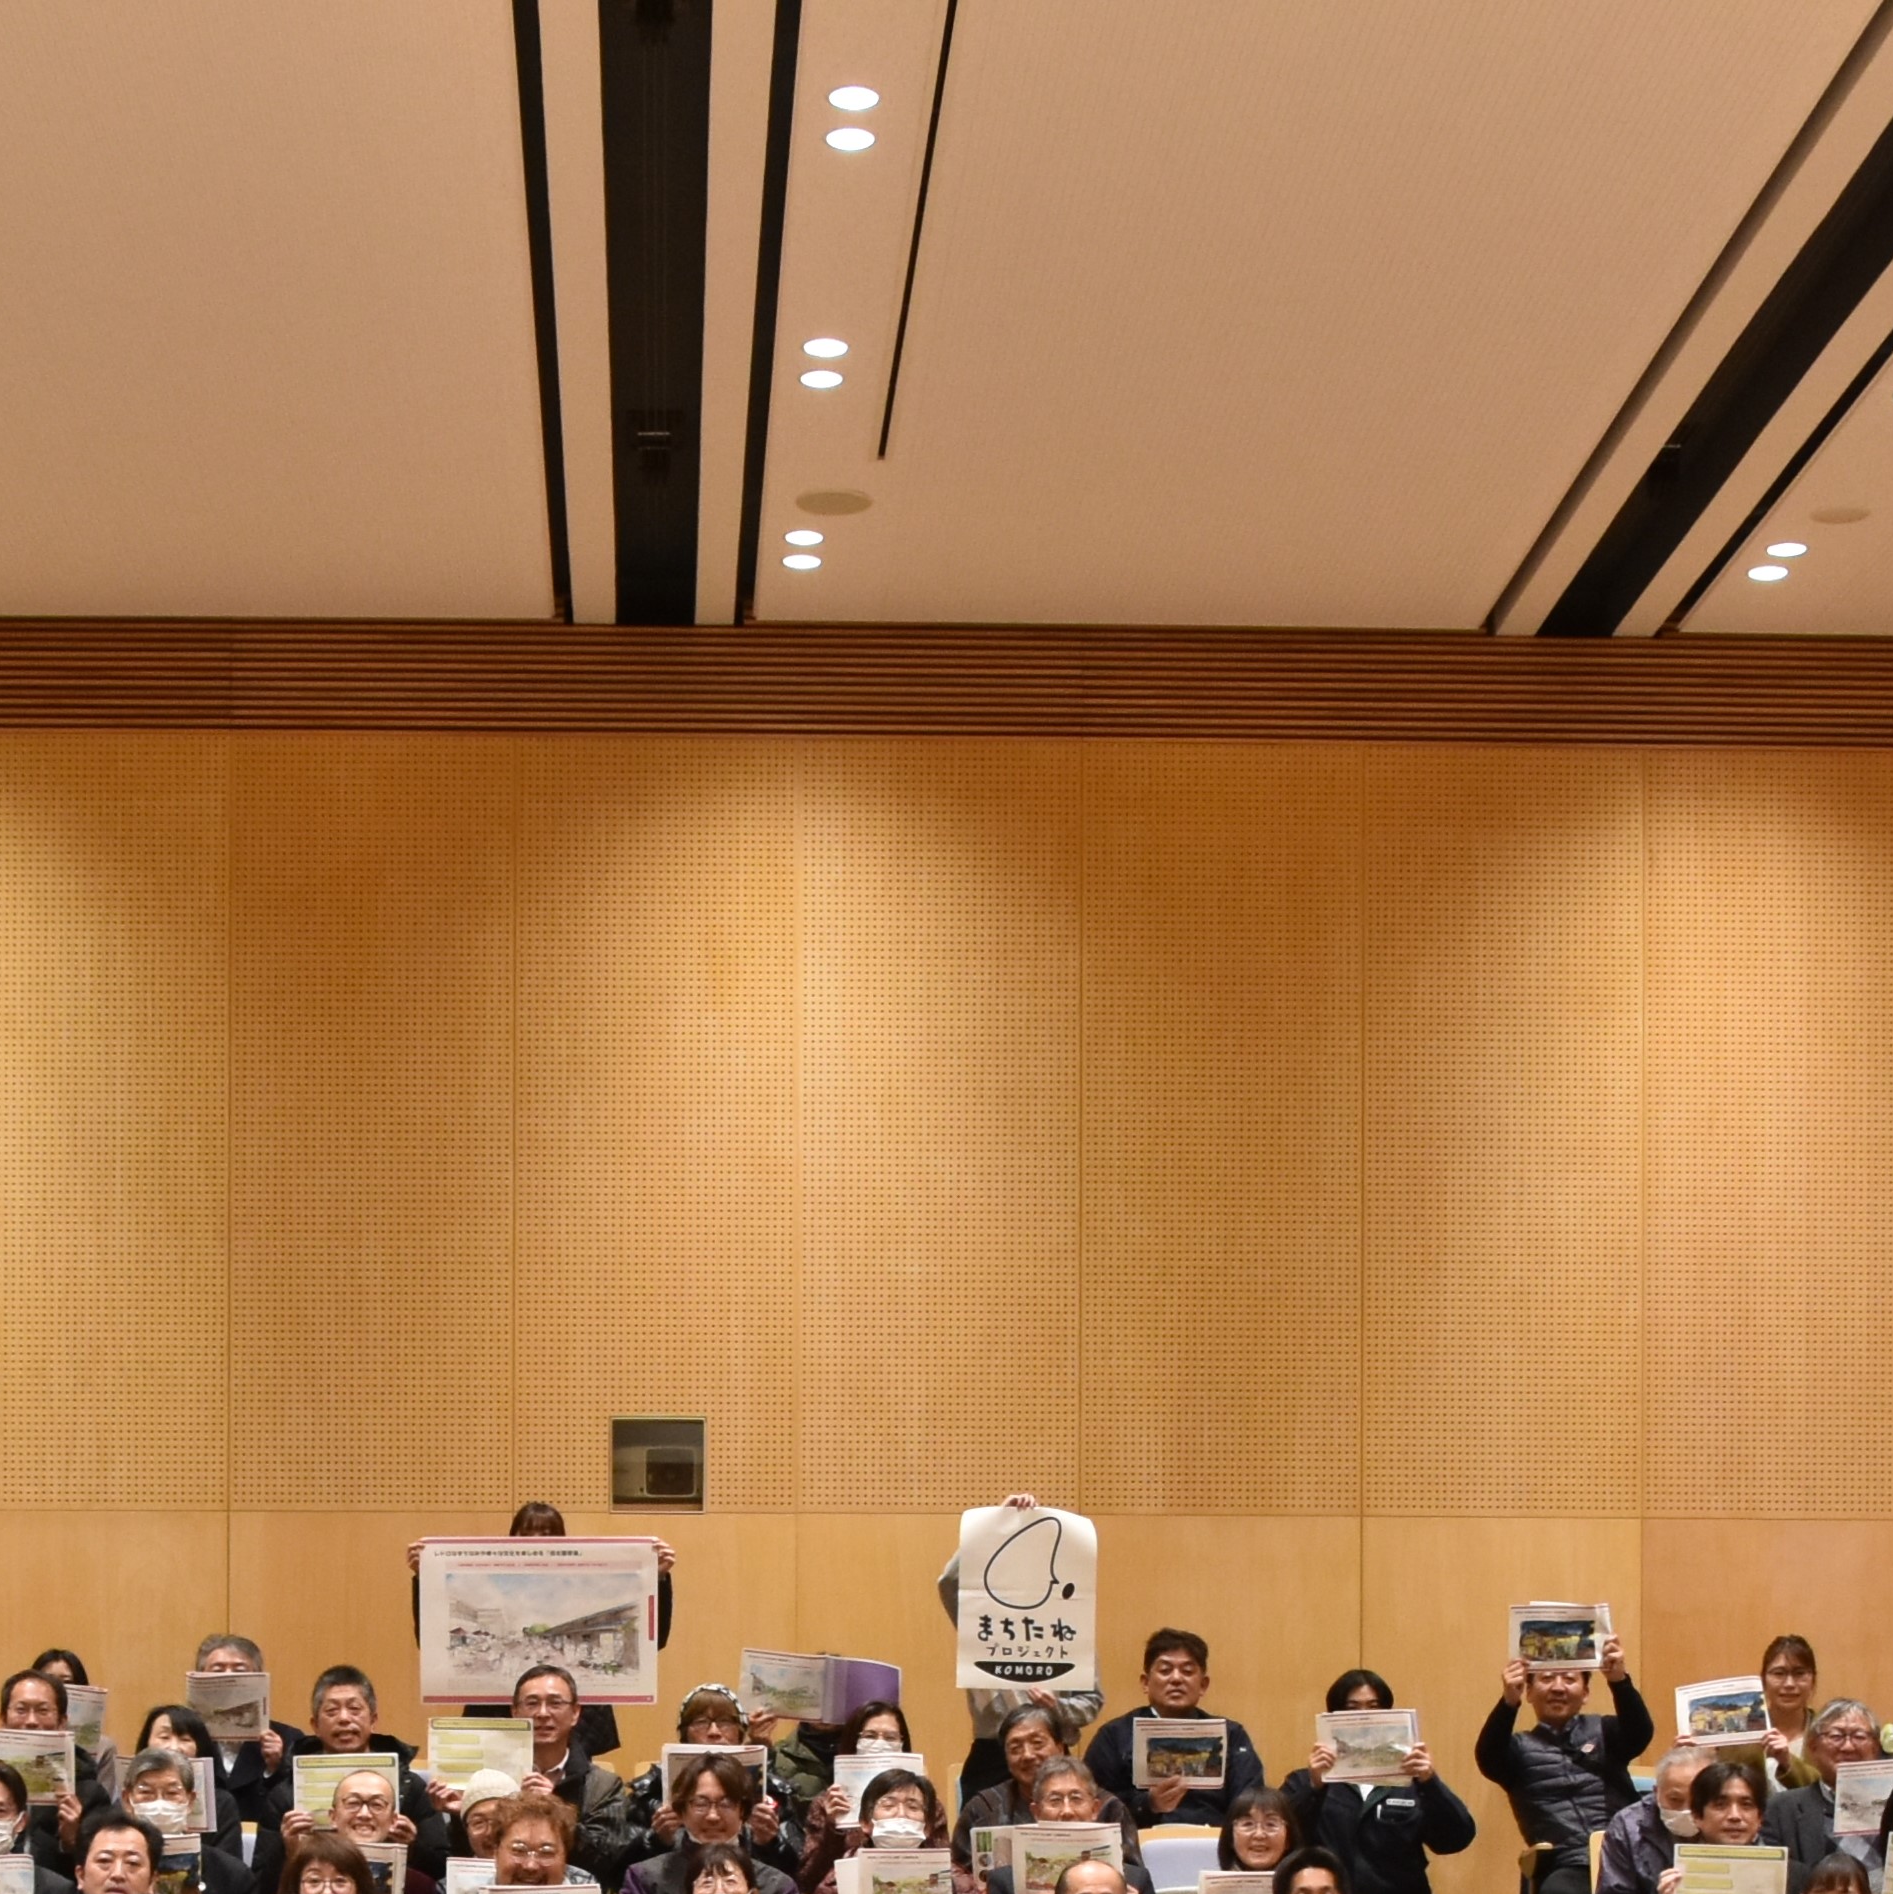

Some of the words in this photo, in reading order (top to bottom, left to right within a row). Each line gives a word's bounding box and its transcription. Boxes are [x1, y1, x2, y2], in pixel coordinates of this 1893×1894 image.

[977, 1615, 1076, 1641] まちたね
[986, 1643, 1069, 1659] プロジェクト
[995, 1665, 1053, 1676] KOMORO
